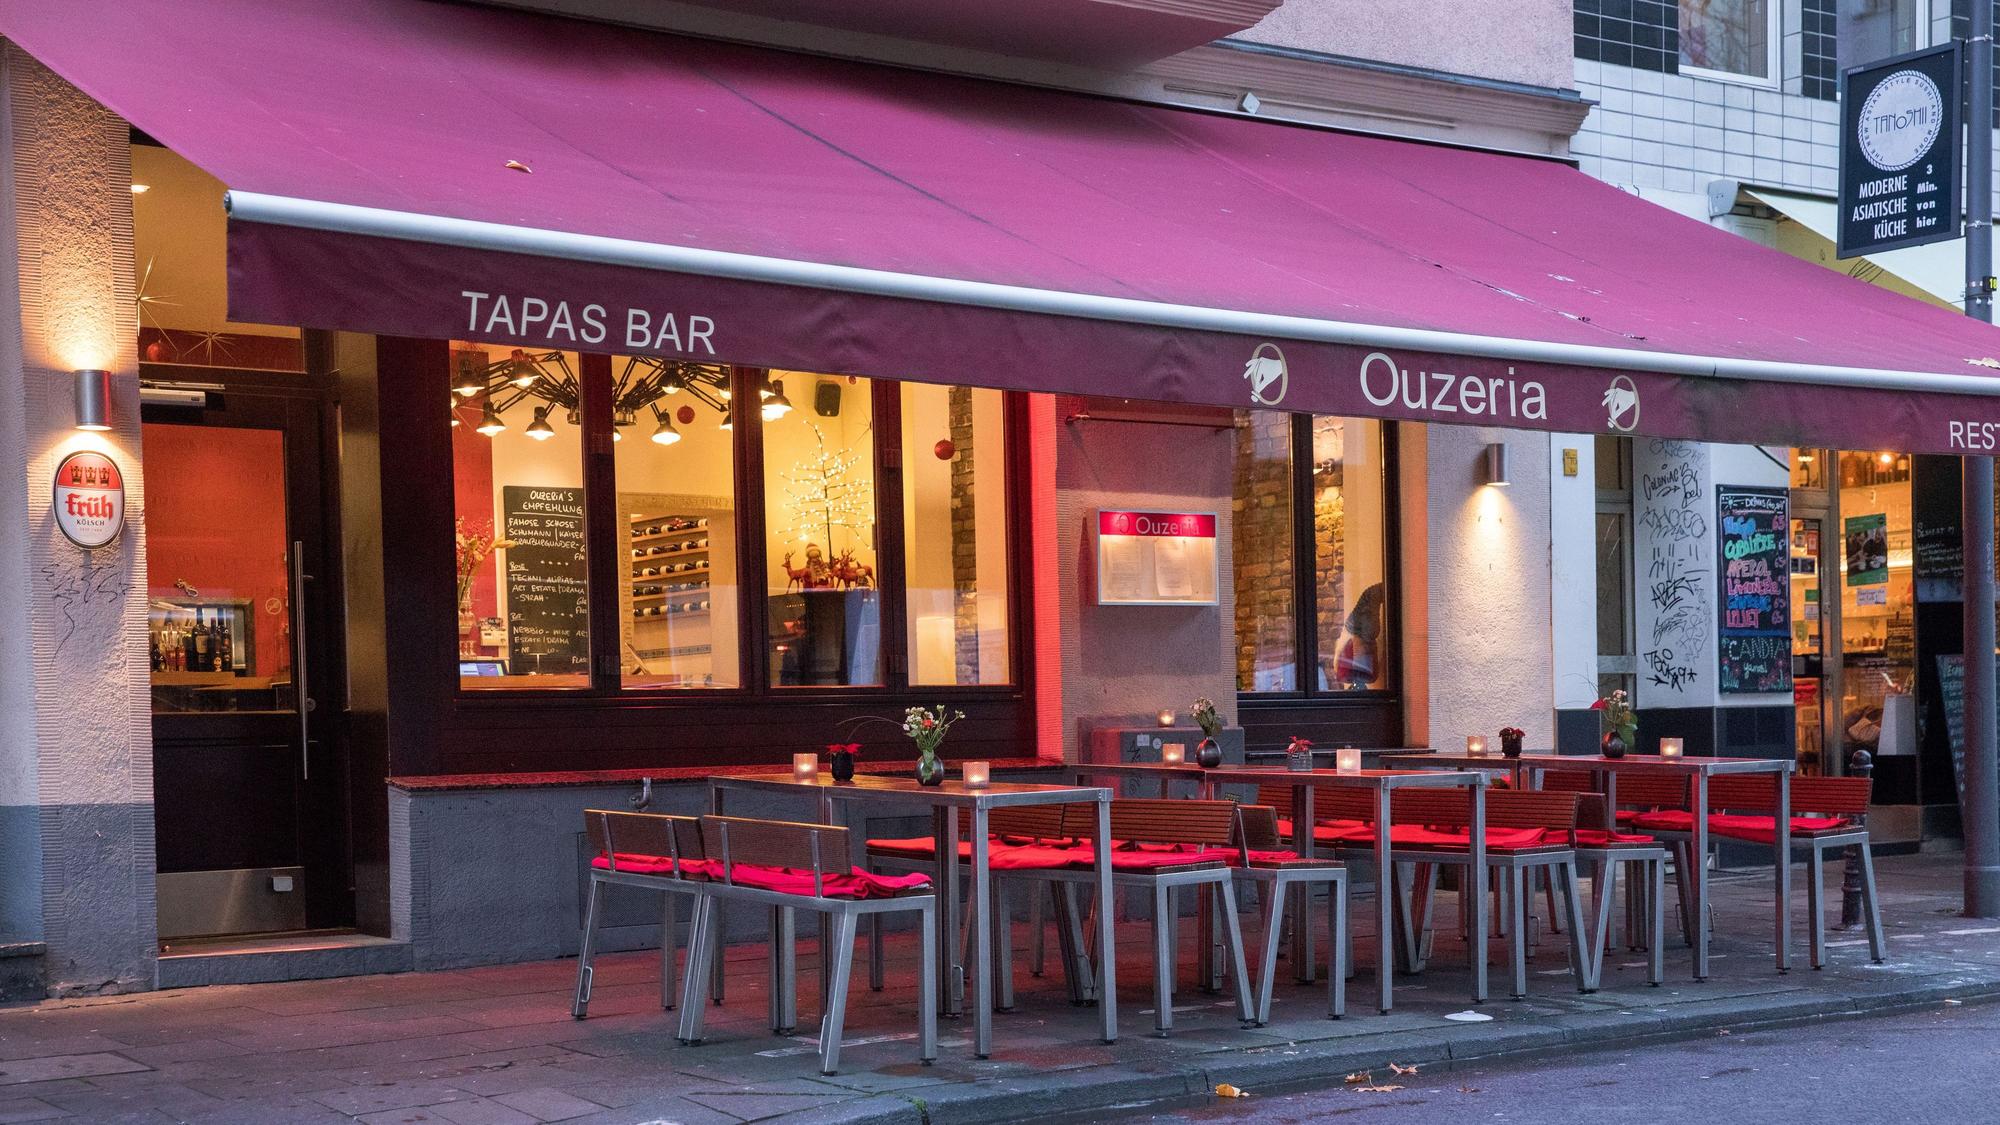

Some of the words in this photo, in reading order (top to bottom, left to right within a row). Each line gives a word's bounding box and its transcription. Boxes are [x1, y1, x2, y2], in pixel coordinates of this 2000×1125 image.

[1884, 77, 1911, 92] STYLE
[1914, 79, 1934, 101] SUSHI
[1865, 92, 1882, 121] ASIAN
[1913, 129, 1933, 154] MORE
[1926, 164, 1933, 175] 3
[1859, 175, 1908, 199] MODERNE
[1917, 183, 1938, 194] Min.
[1852, 197, 1907, 222] ASIATISCHE
[1916, 200, 1936, 211] von
[1874, 219, 1907, 240] KÜCHE
[1916, 216, 1937, 228] hier
[461, 290, 607, 344] TAPAS
[626, 308, 716, 355] BAR
[1359, 352, 1548, 420] Ouzeria
[76, 518, 105, 526] KÖLSCH
